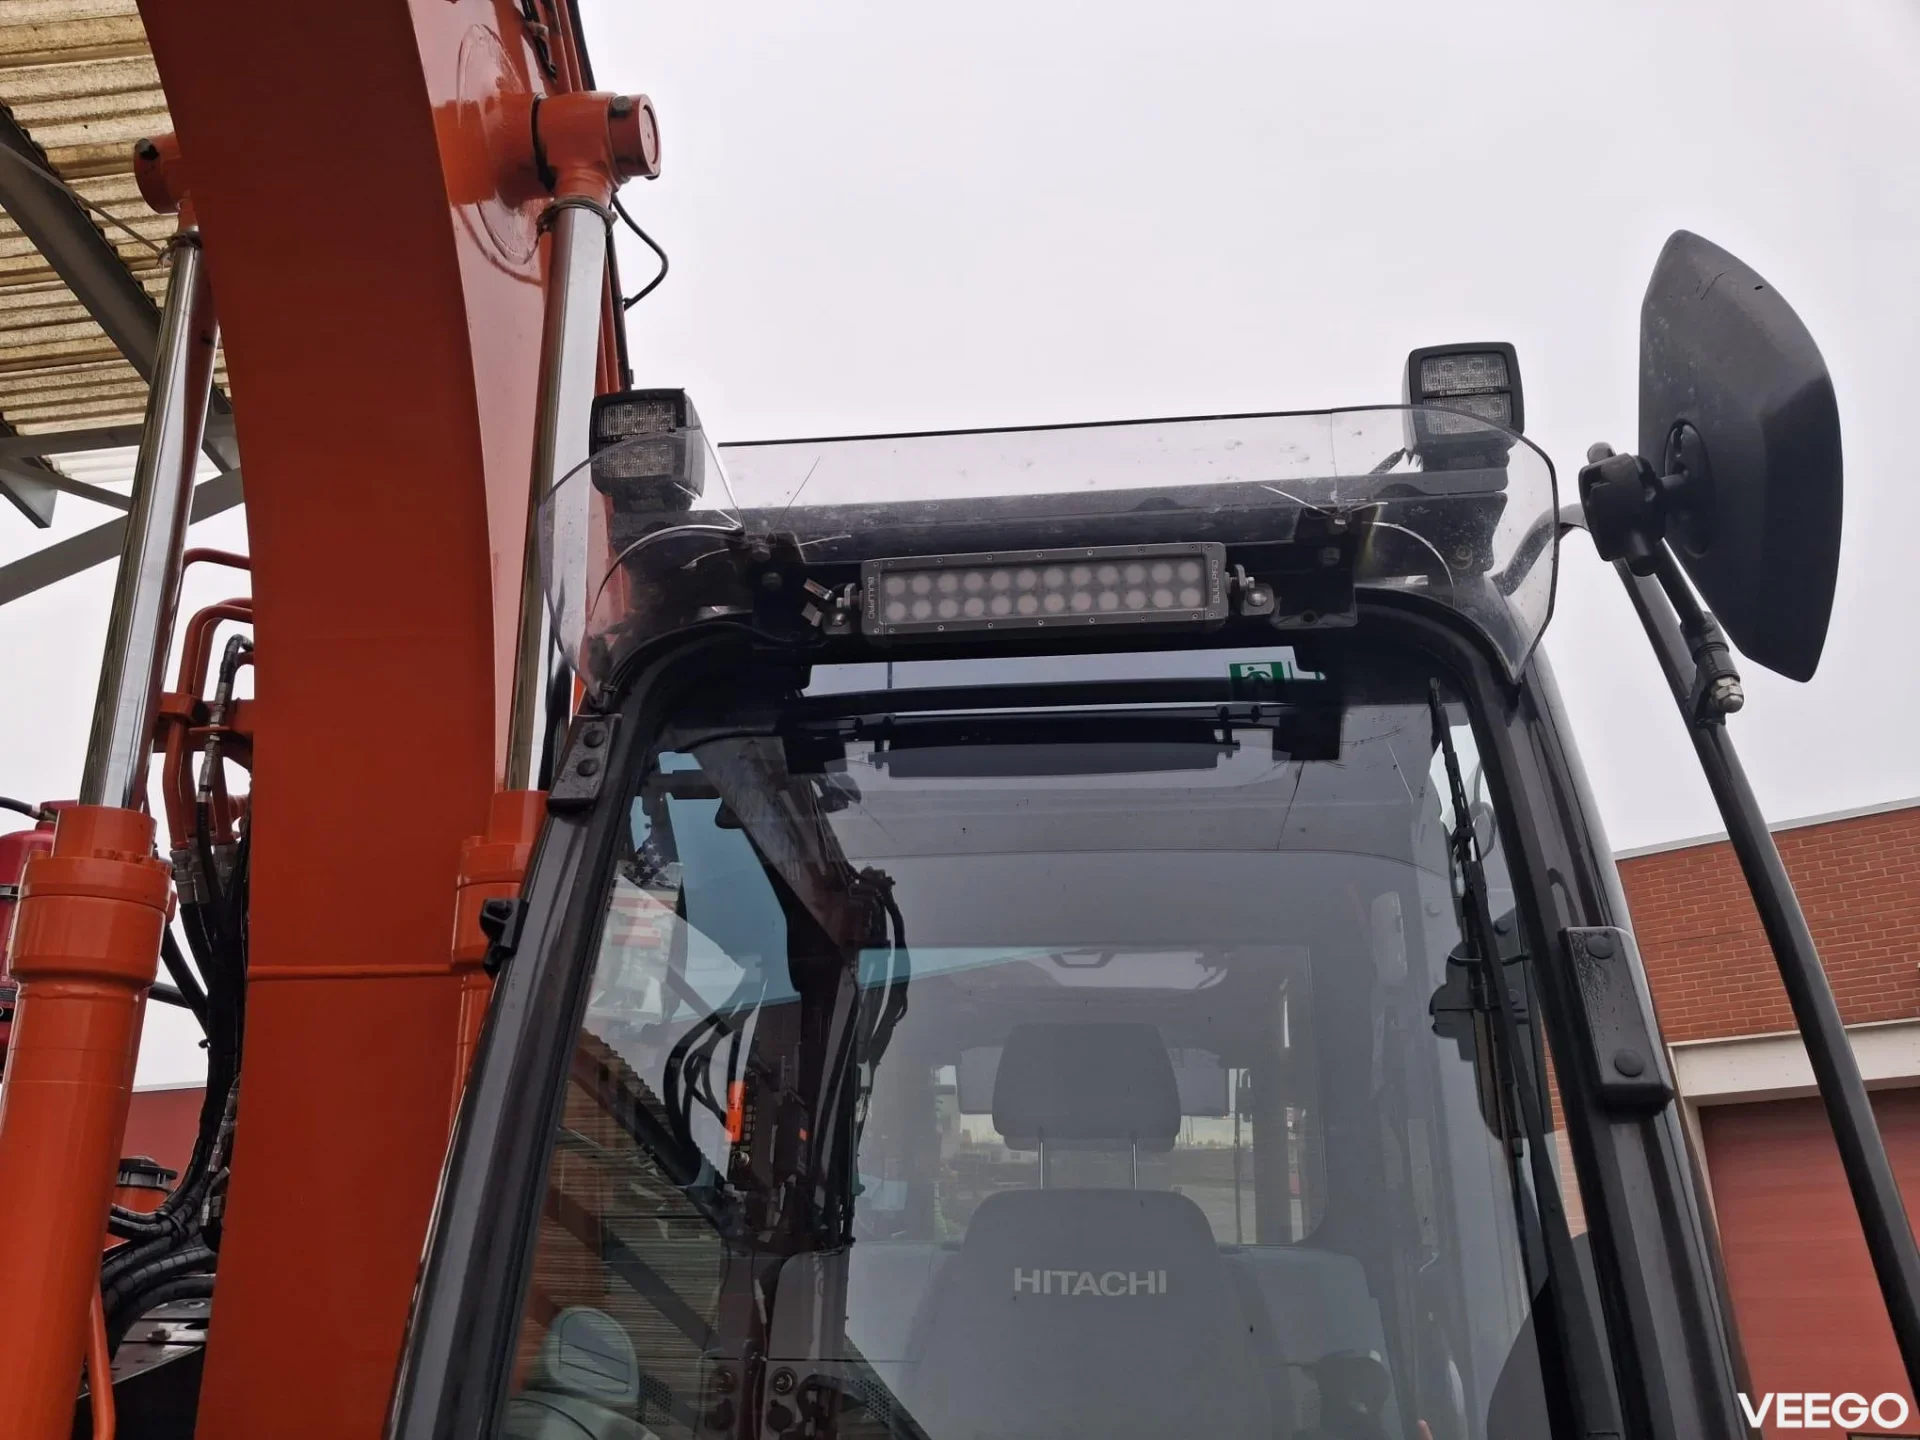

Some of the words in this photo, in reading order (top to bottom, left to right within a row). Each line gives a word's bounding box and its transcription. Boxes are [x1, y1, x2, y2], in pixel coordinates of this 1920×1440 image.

[867, 576, 875, 619] BULLPRO
[1211, 559, 1220, 603] BULLPRO
[1014, 1267, 1167, 1297] HITACHI
